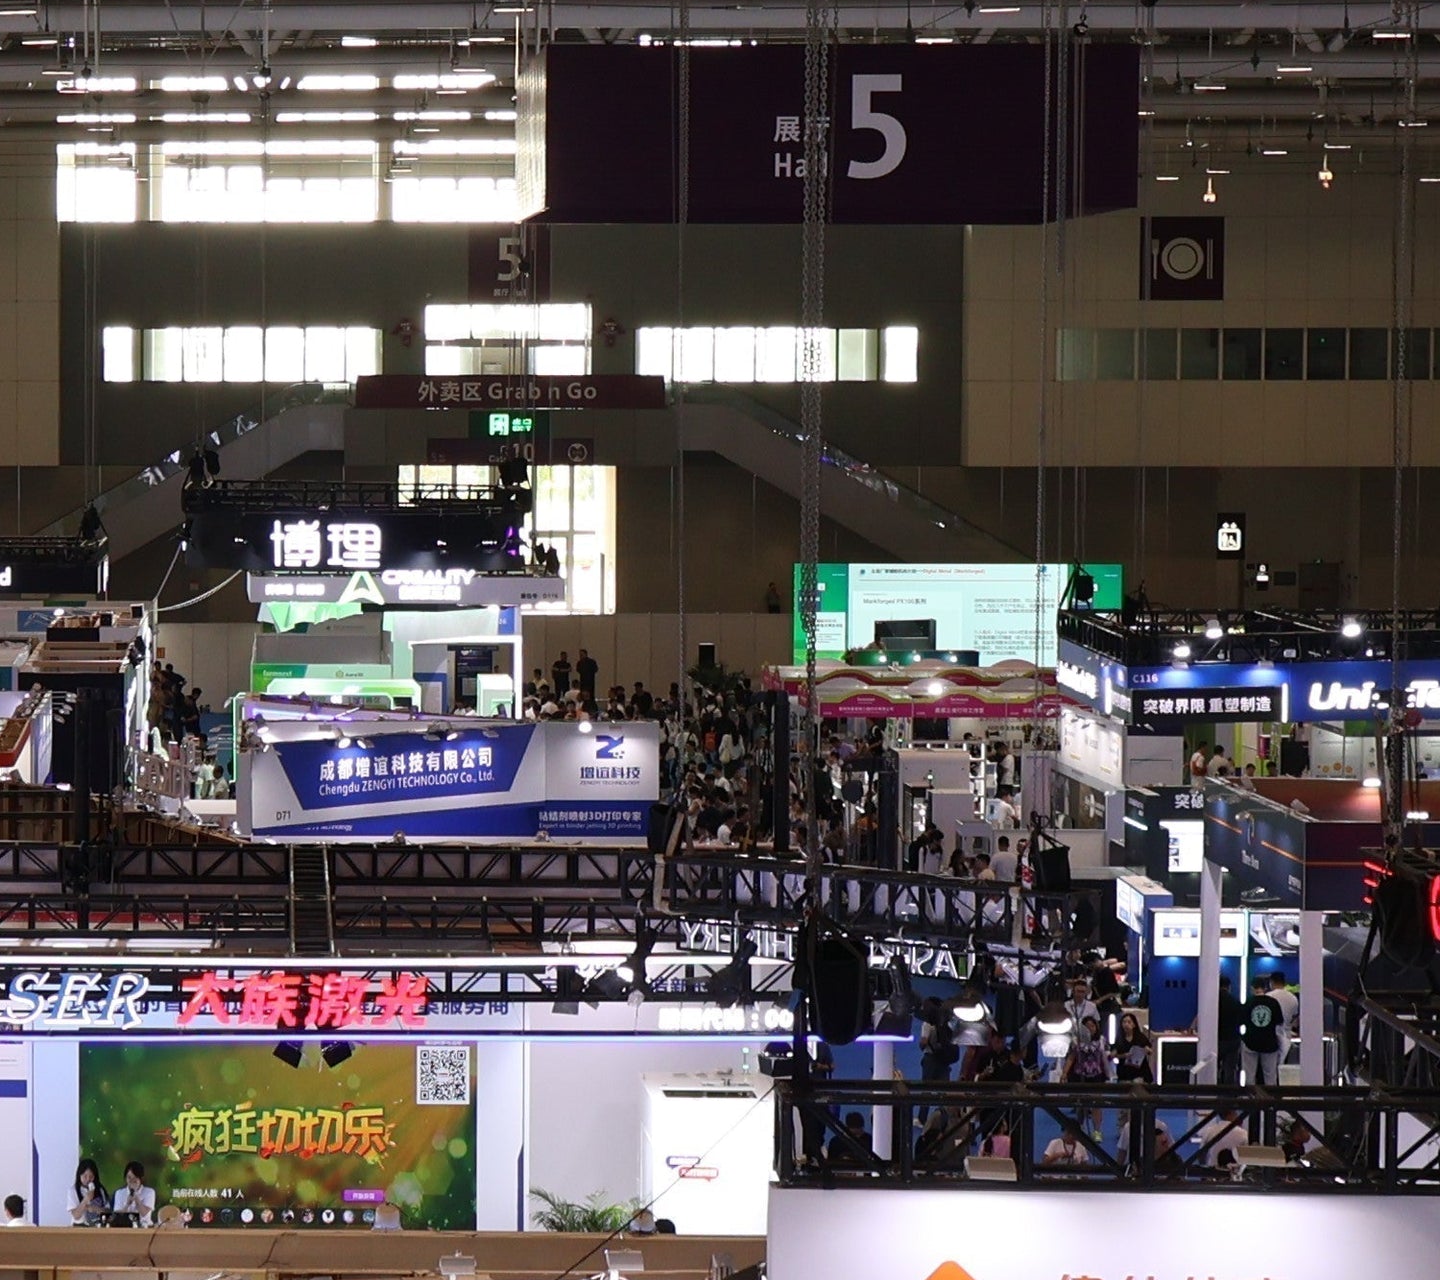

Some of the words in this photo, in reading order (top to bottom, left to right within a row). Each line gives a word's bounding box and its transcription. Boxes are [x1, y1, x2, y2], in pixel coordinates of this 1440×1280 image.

[847, 74, 907, 179] 5
[496, 236, 520, 281] 5
[417, 383, 482, 404] 外卖区
[487, 382, 542, 404] Grab
[566, 382, 597, 404] Go
[1133, 673, 1159, 684] C116
[1143, 698, 1205, 714] 突破界限
[1209, 697, 1271, 713] 重塑制造
[319, 747, 493, 782] 成都增谊科技有限公司
[579, 767, 641, 780] 增谊科技
[318, 781, 360, 798] Chengdu
[361, 778, 396, 793] ZENGYI
[397, 773, 459, 790] TECHNOLOGY
[275, 810, 292, 822] D71
[177, 972, 430, 1028] 大族激光
[172, 1105, 388, 1156] 疯狂切切乐
[220, 1187, 233, 1199] 41
[236, 1187, 244, 1199] 人
